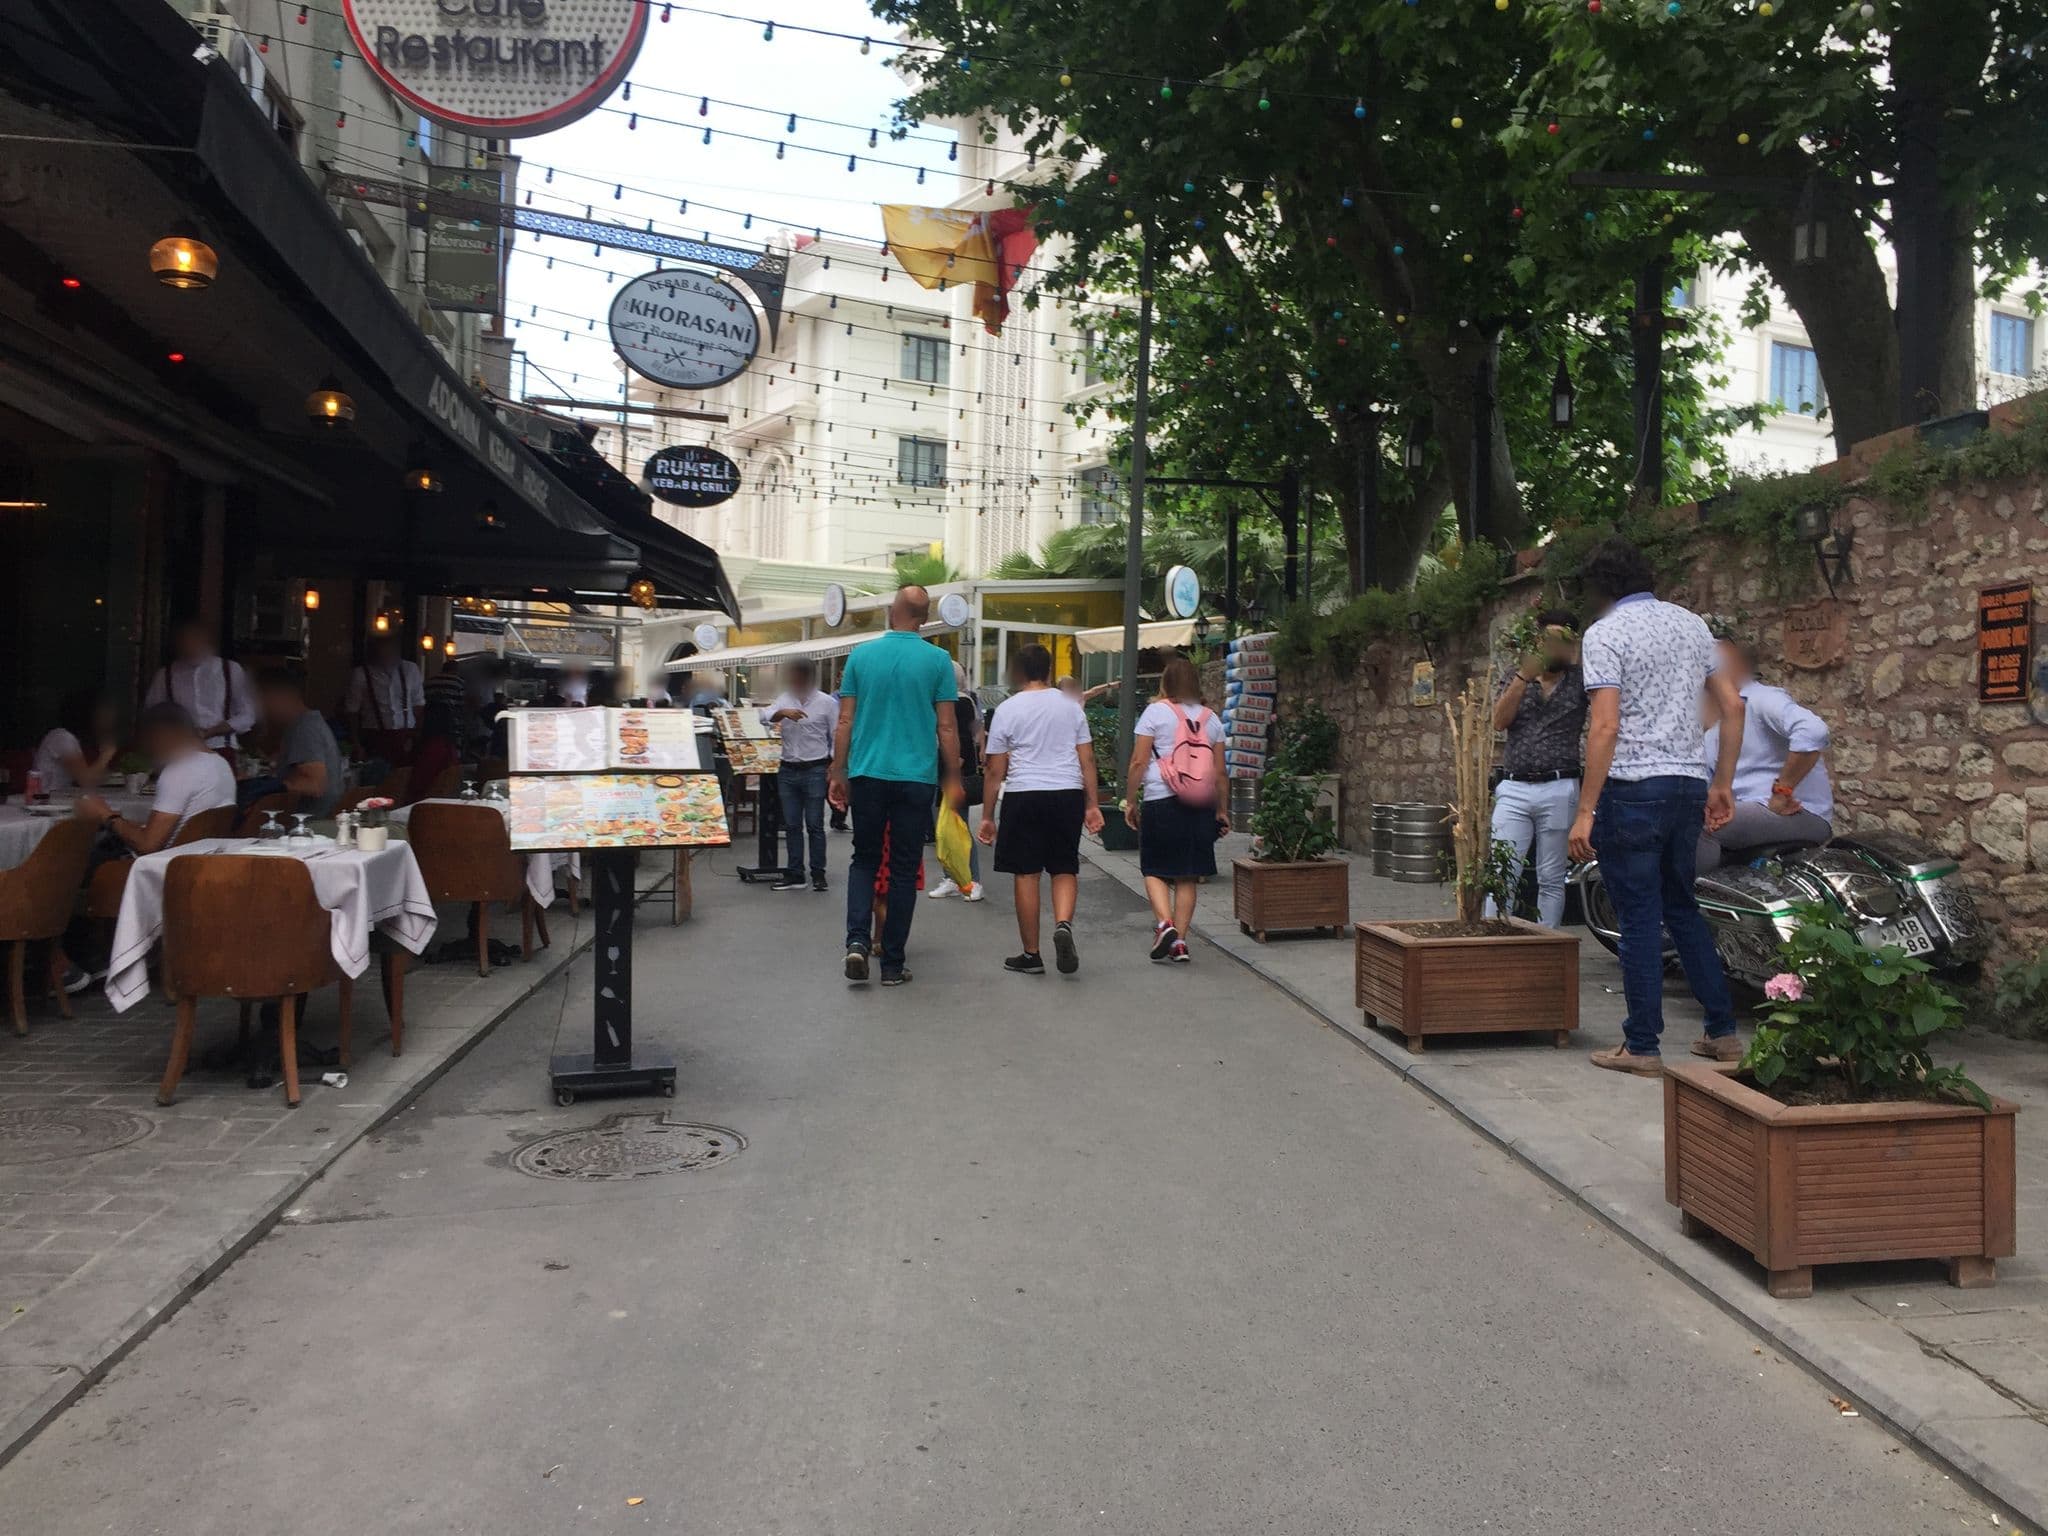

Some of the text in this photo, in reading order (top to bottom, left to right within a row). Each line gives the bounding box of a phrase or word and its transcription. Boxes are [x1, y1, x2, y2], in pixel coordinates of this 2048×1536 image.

[376, 25, 605, 67] Restaurant
[693, 282, 701, 291] &
[705, 286, 733, 308] GRI
[652, 477, 732, 493] KEBAB & GRILL
[1896, 920, 1919, 936] HB
